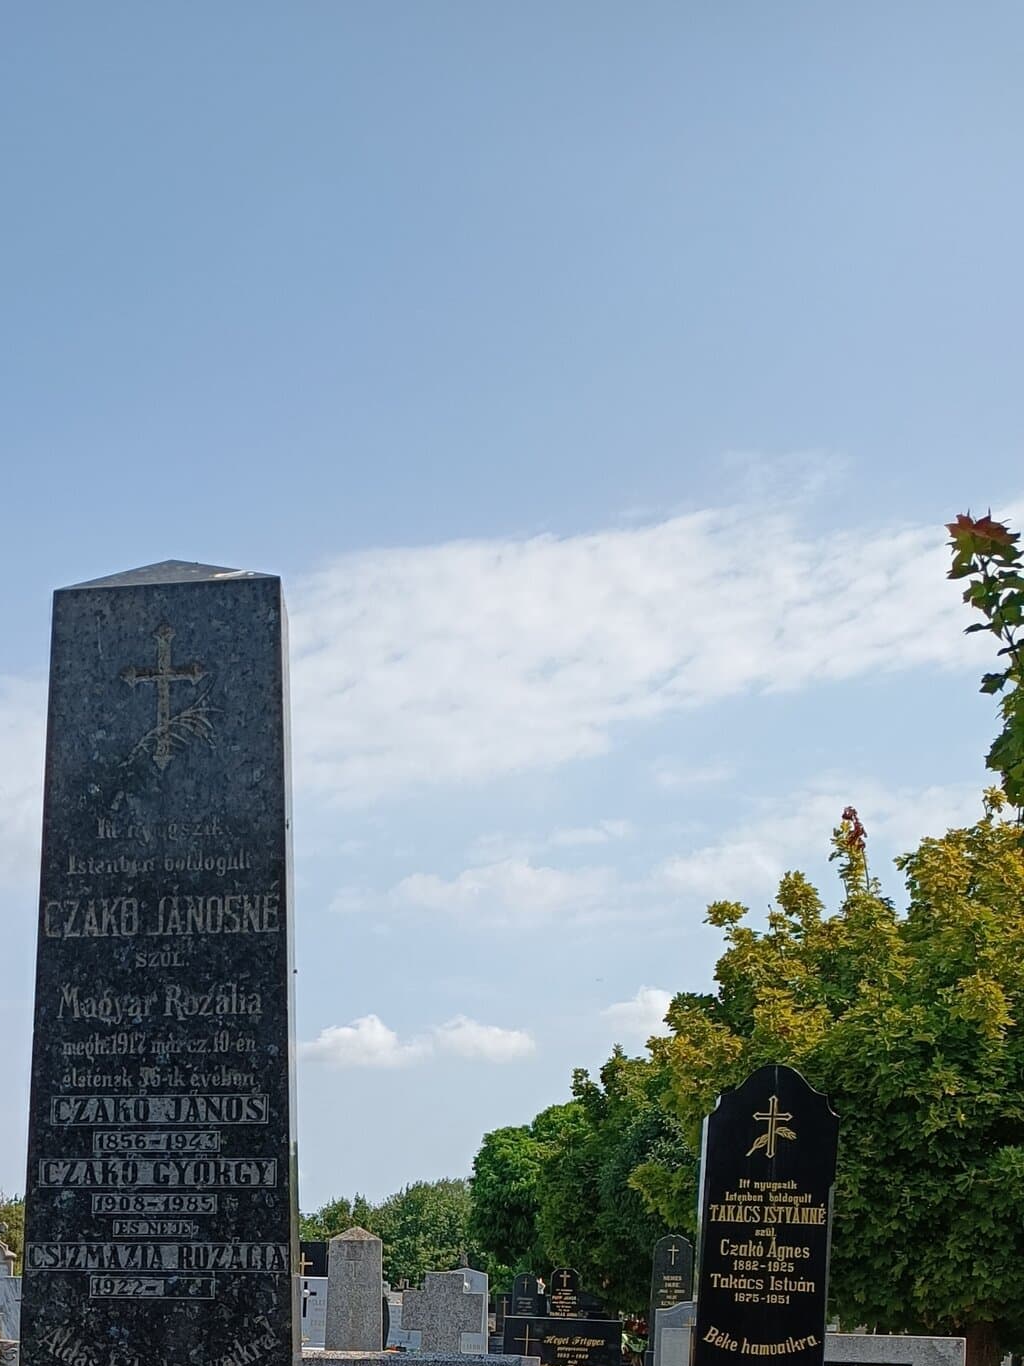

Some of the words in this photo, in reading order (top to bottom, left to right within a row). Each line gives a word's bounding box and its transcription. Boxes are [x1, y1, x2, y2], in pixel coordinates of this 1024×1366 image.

[44, 887, 139, 938] CZAKÓ
[146, 883, 280, 936] JÁNOSNÉ
[56, 984, 158, 1024] Magyar
[163, 981, 263, 1020] Rozália
[53, 1090, 150, 1122] CZAKÓ
[165, 1090, 266, 1122] JÁNOS
[42, 1154, 139, 1185] CZAKÓ
[153, 1154, 274, 1186] GYÖRGY
[739, 1179, 751, 1188] Itt
[754, 1180, 798, 1191] nyugszik
[725, 1191, 763, 1202] Istenben
[769, 1192, 812, 1206] boldogult
[709, 1201, 761, 1222] TAKÁCS
[763, 1203, 826, 1225] ISTVÁNNÉ
[720, 1239, 764, 1257] Czakó
[766, 1237, 810, 1261] Ágnes
[710, 1273, 764, 1290] Takács
[770, 1276, 815, 1292] István
[703, 1325, 738, 1352] Béke
